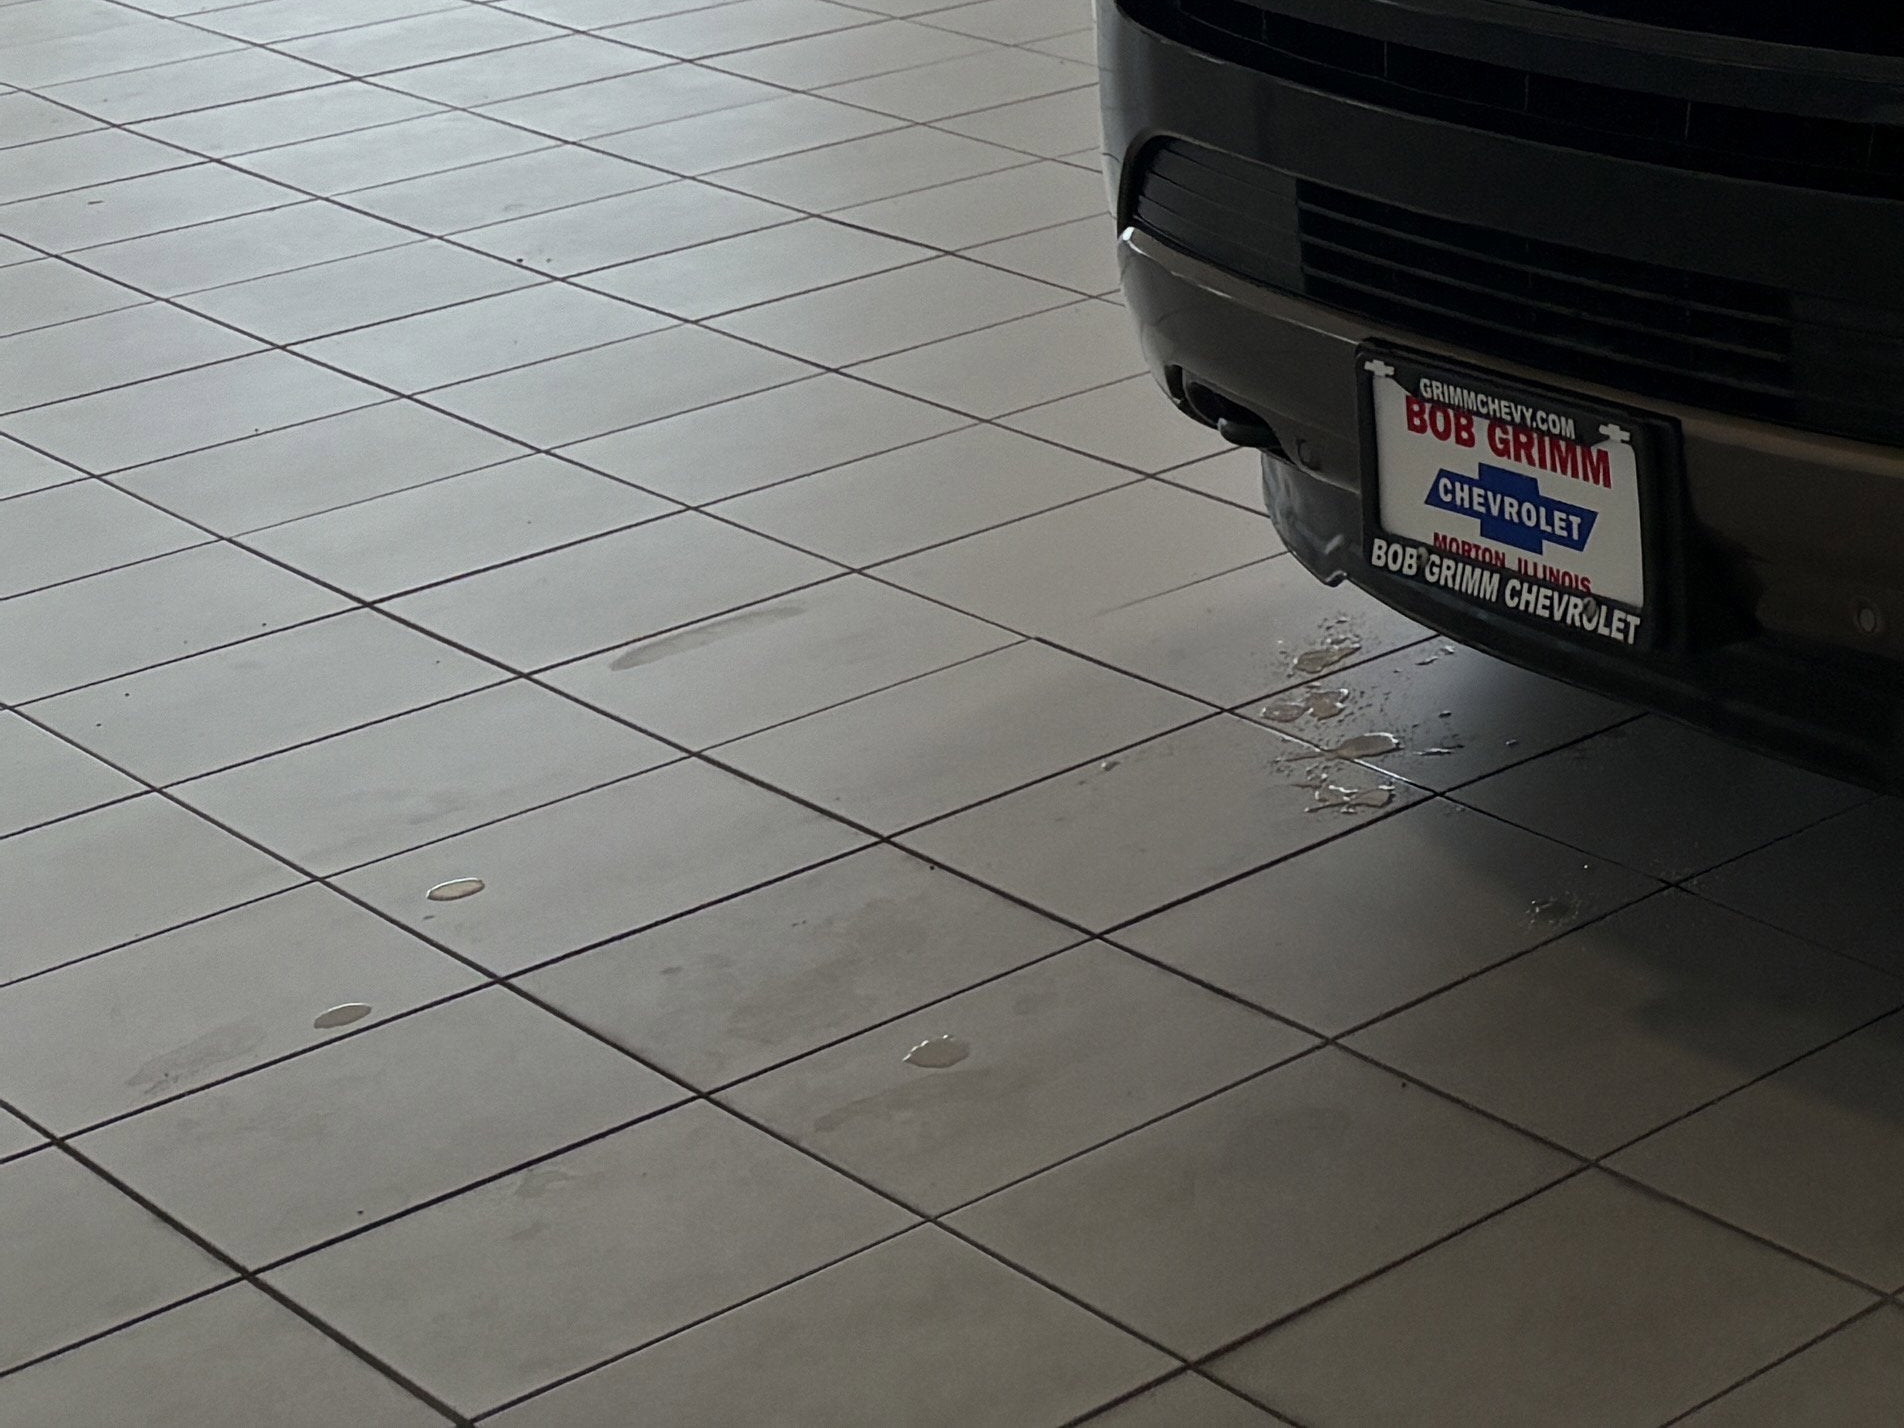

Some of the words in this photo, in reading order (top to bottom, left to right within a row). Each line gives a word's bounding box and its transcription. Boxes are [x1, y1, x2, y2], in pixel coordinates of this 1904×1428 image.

[1419, 377, 1576, 440] GRIMMCHEVY.COM
[1405, 394, 1476, 449] BOB
[1487, 419, 1612, 489] GRIMM
[1438, 477, 1582, 541] CHEVROLET
[1371, 538, 1417, 576] BOB
[1425, 553, 1500, 602] GRIMM
[1433, 531, 1506, 568] MORTON
[1516, 556, 1592, 594] ILLINOIS
